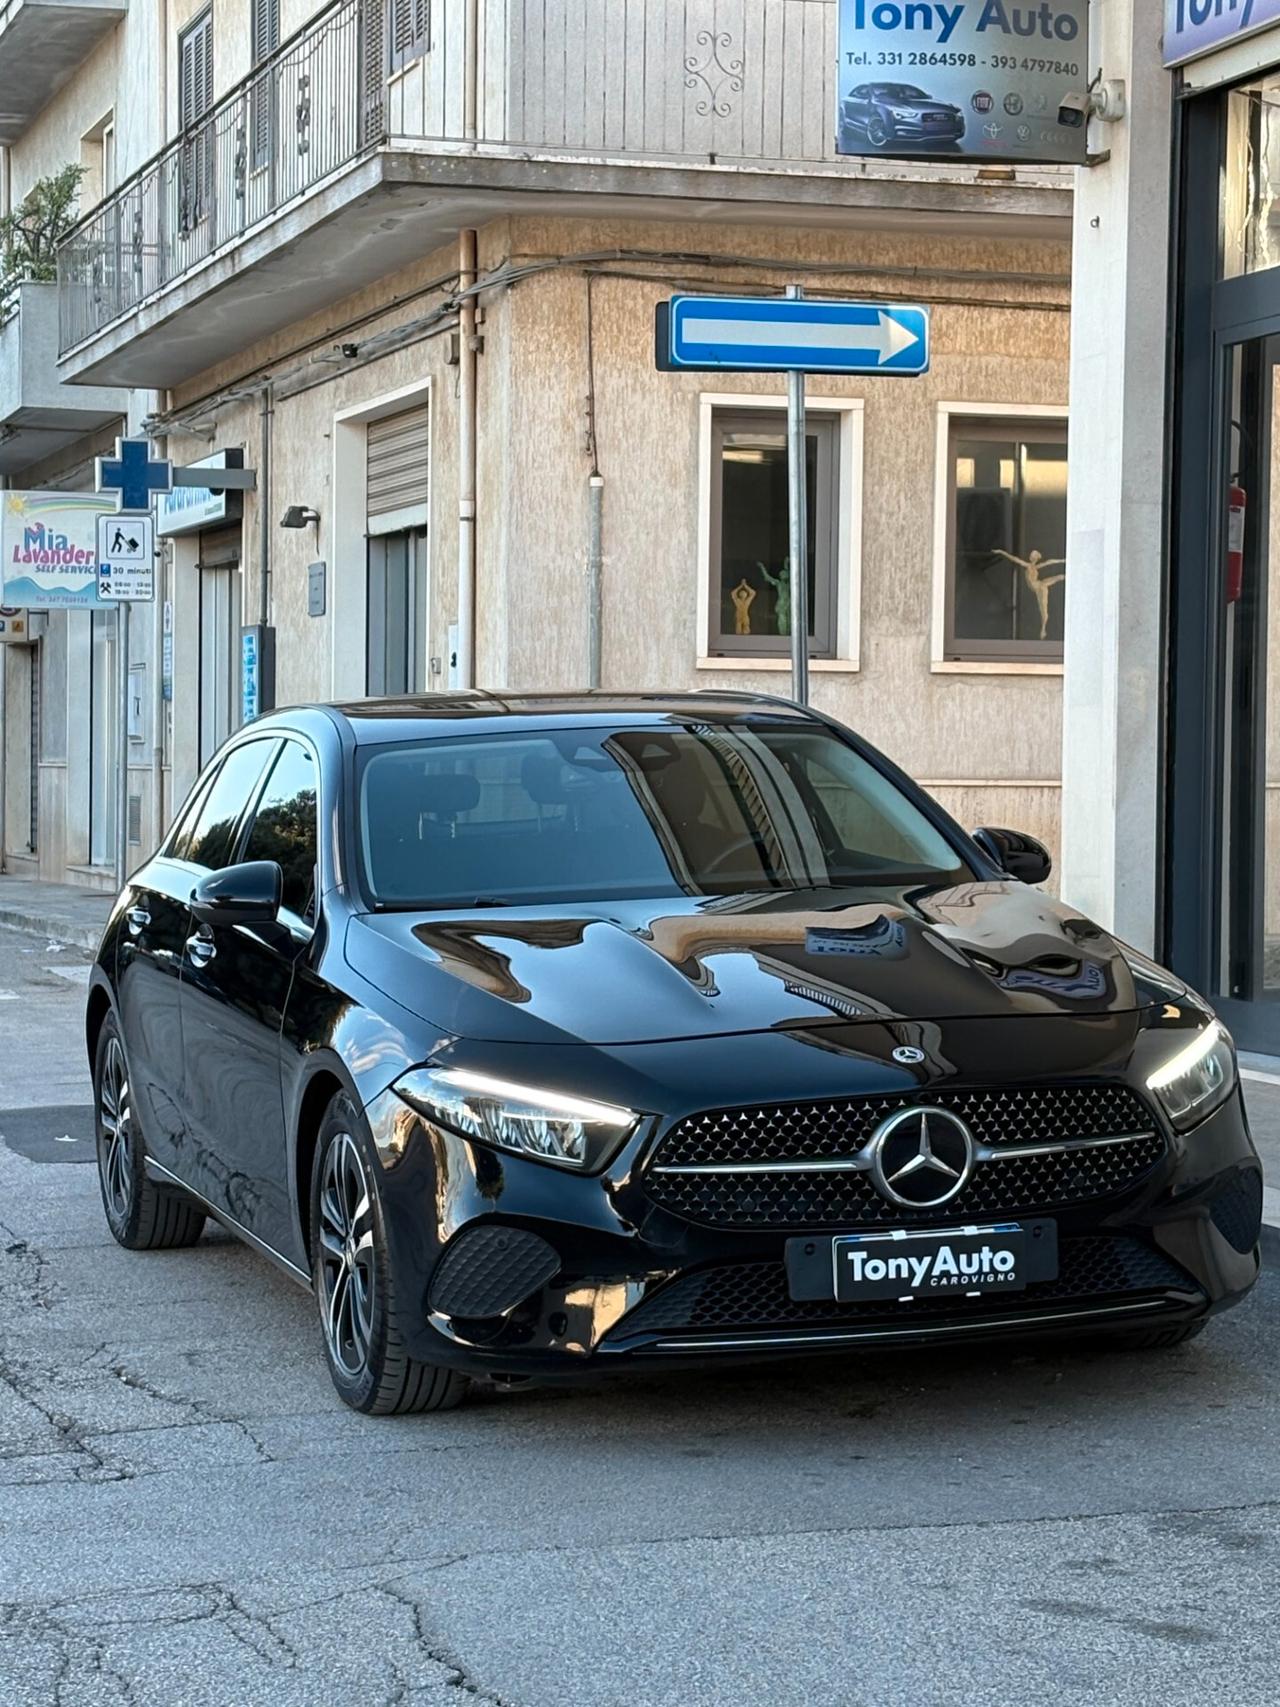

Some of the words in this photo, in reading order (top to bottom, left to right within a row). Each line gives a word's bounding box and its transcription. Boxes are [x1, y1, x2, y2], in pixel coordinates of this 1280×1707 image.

[976, 0, 1078, 41] Auto
[846, 52, 872, 65] Tel.
[877, 52, 902, 65] 331
[908, 52, 976, 67] 2864598
[991, 55, 1017, 69] 393
[1020, 57, 1079, 76] 4797840
[24, 522, 68, 551] Mia
[13, 544, 97, 564] Lavander
[35, 564, 57, 573] SELF
[58, 565, 96, 575] SERVIC
[848, 1246, 1016, 1287] TonyAuto
[930, 1272, 1017, 1287] CAROVIGNO
